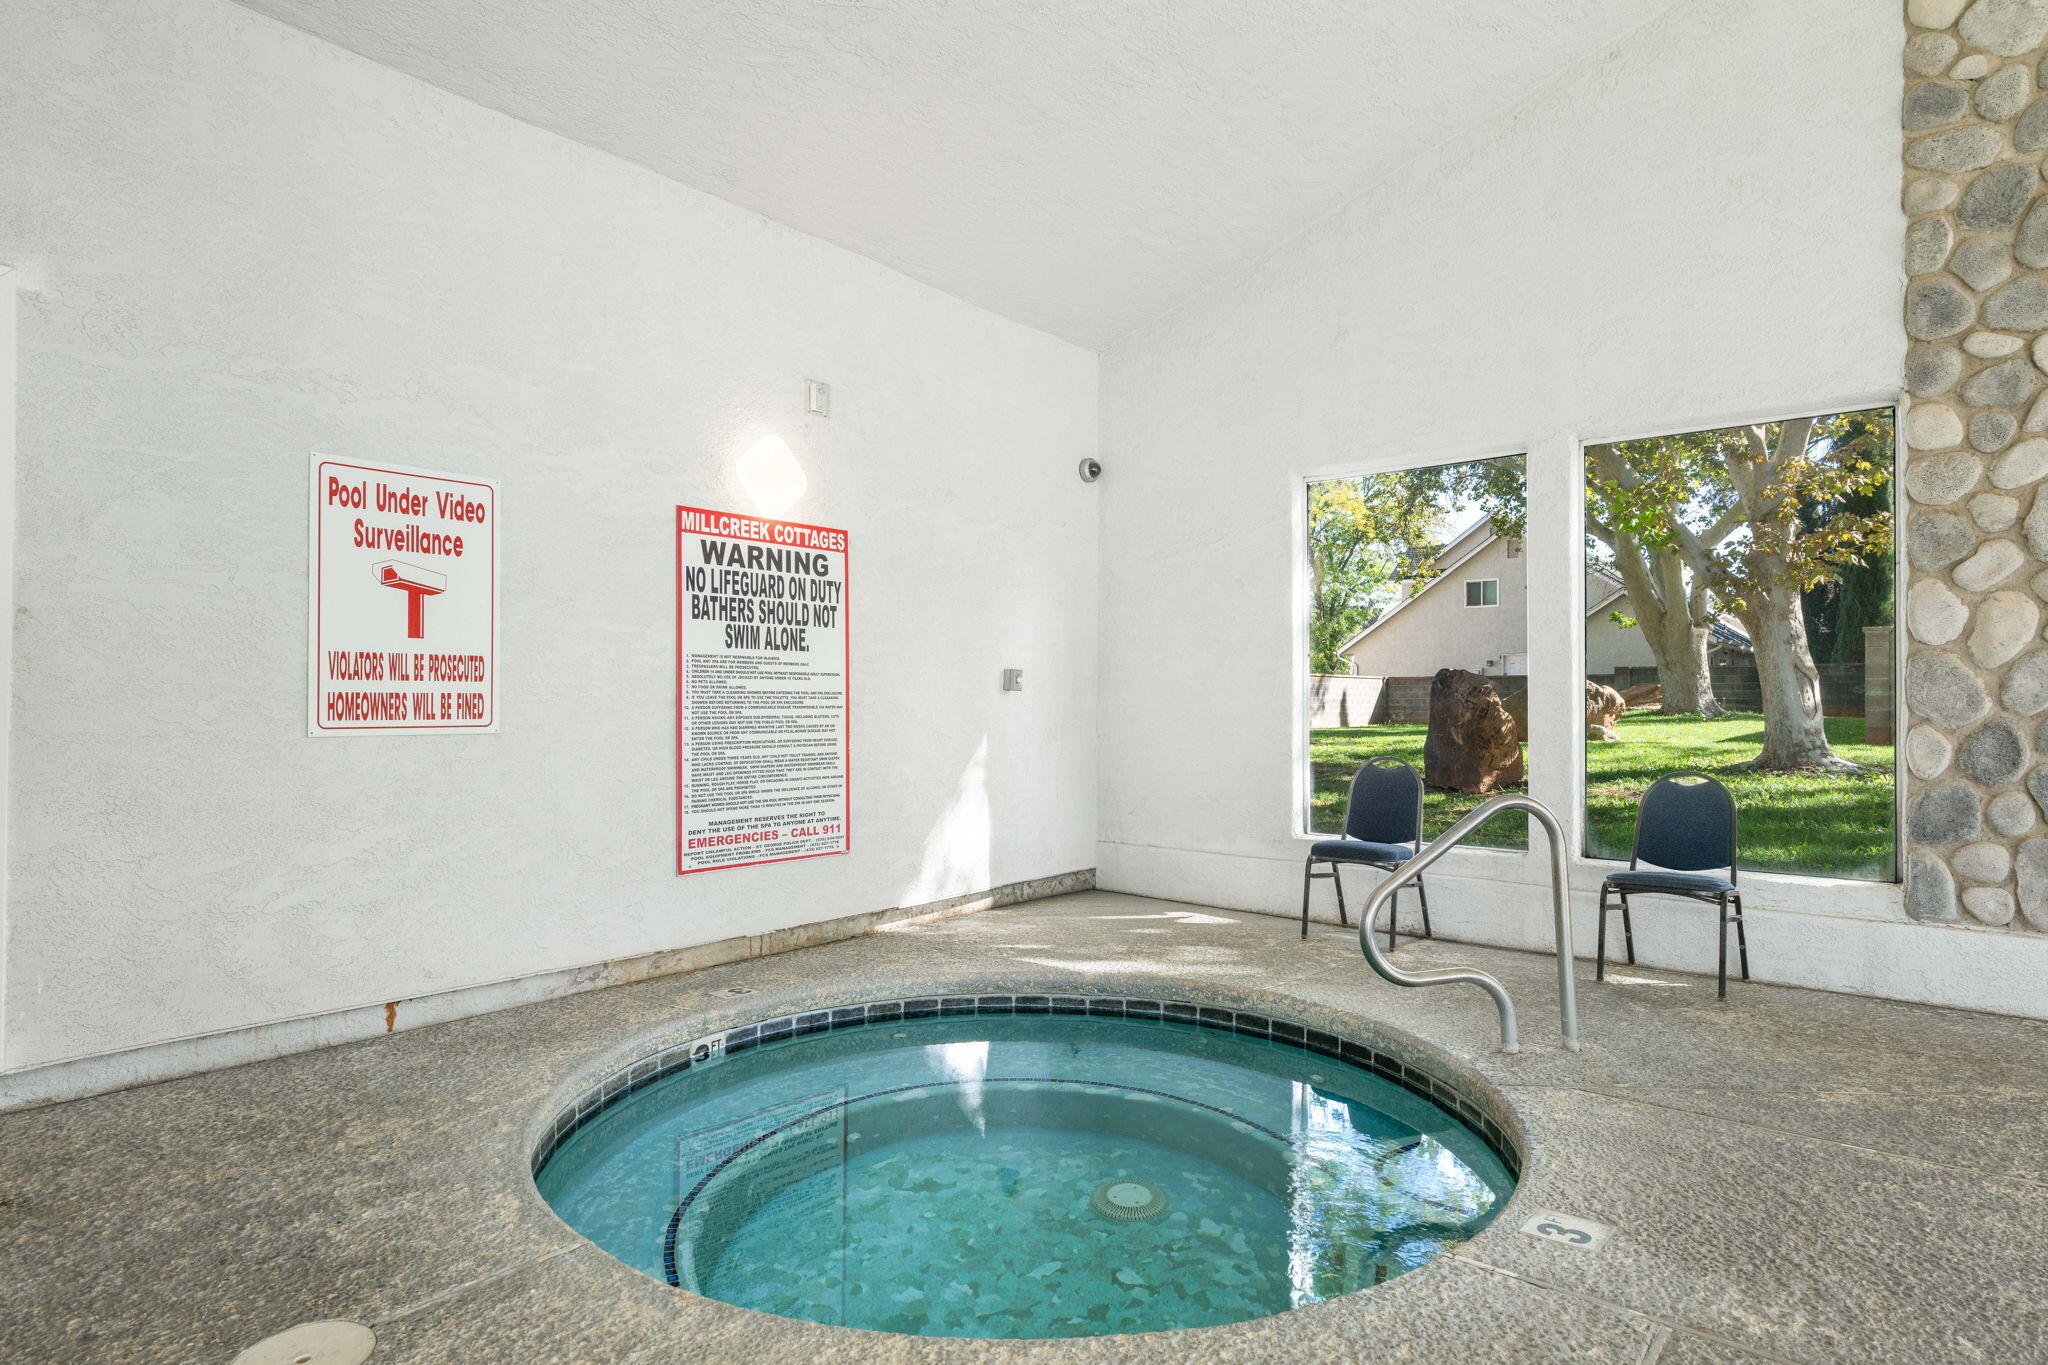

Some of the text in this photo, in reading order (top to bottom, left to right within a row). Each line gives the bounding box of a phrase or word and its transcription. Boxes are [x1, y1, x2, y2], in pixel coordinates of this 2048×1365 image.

[328, 476, 485, 523] Pool Under Video
[354, 518, 463, 557] Surveillance
[681, 510, 845, 550] MILLCREEK COTTAGES
[701, 539, 828, 577] WARNING
[686, 566, 842, 604] NO LIFEGUARD ON DUTY
[692, 594, 837, 628] BATHERS SHOULD NOT
[725, 624, 809, 652] SWIM ALONE.
[328, 651, 485, 682] VIOLATORS WILL BE PROSECUTED
[327, 692, 485, 721] HOMEOWNERS WILL BE FINED
[708, 818, 752, 826] MANAGEMENT
[754, 814, 785, 822] RESERVES
[688, 830, 779, 849] EMERGENCIES
[791, 826, 819, 838] CALL
[823, 824, 841, 834] 911
[705, 847, 733, 855] UNLAWFUL
[692, 1043, 710, 1062] 3
[1537, 1223, 1592, 1244] 3
